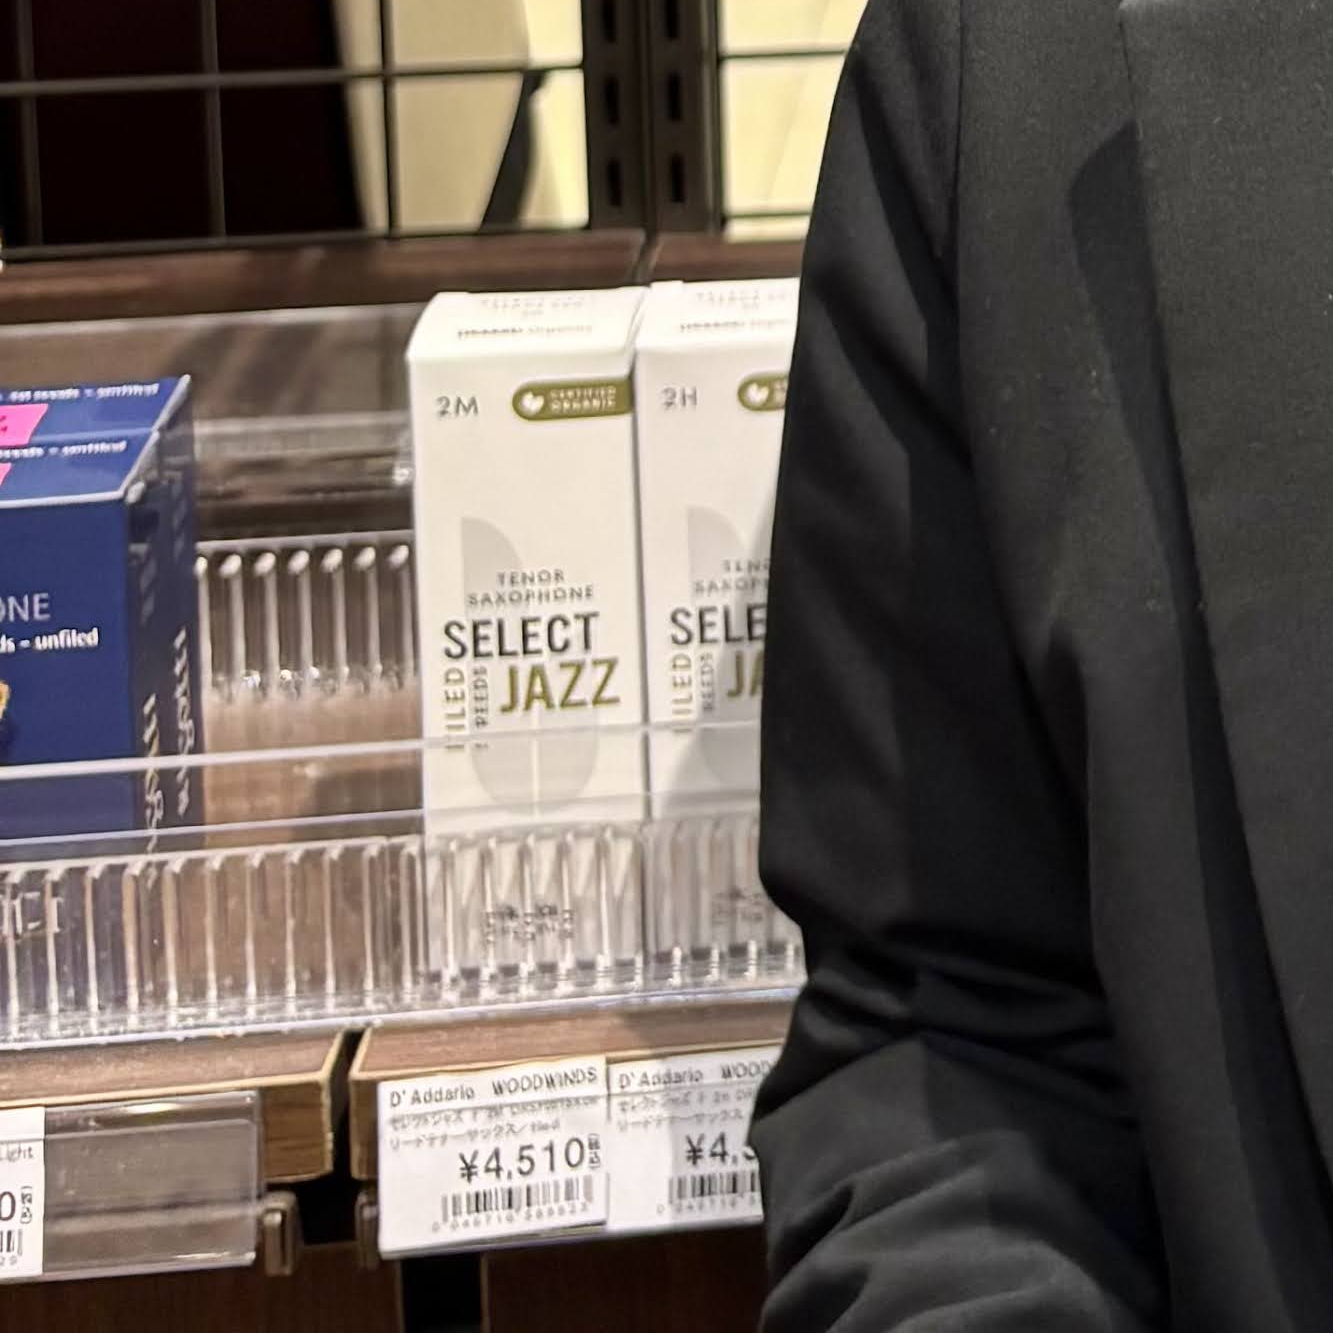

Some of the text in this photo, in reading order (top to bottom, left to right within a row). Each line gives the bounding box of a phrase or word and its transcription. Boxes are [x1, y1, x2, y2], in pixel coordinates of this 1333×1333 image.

[434, 395, 479, 420] 2M
[659, 386, 698, 411] 2H
[497, 568, 565, 587] TENOR
[468, 584, 594, 608] SAXOPHONE
[34, 627, 99, 651] unfiled
[443, 610, 600, 661] SELECT
[669, 603, 767, 647] SELE
[500, 656, 621, 715] JAZZ
[491, 1066, 598, 1097] WOODWINDS
[457, 1136, 586, 1183] ¥4,510
